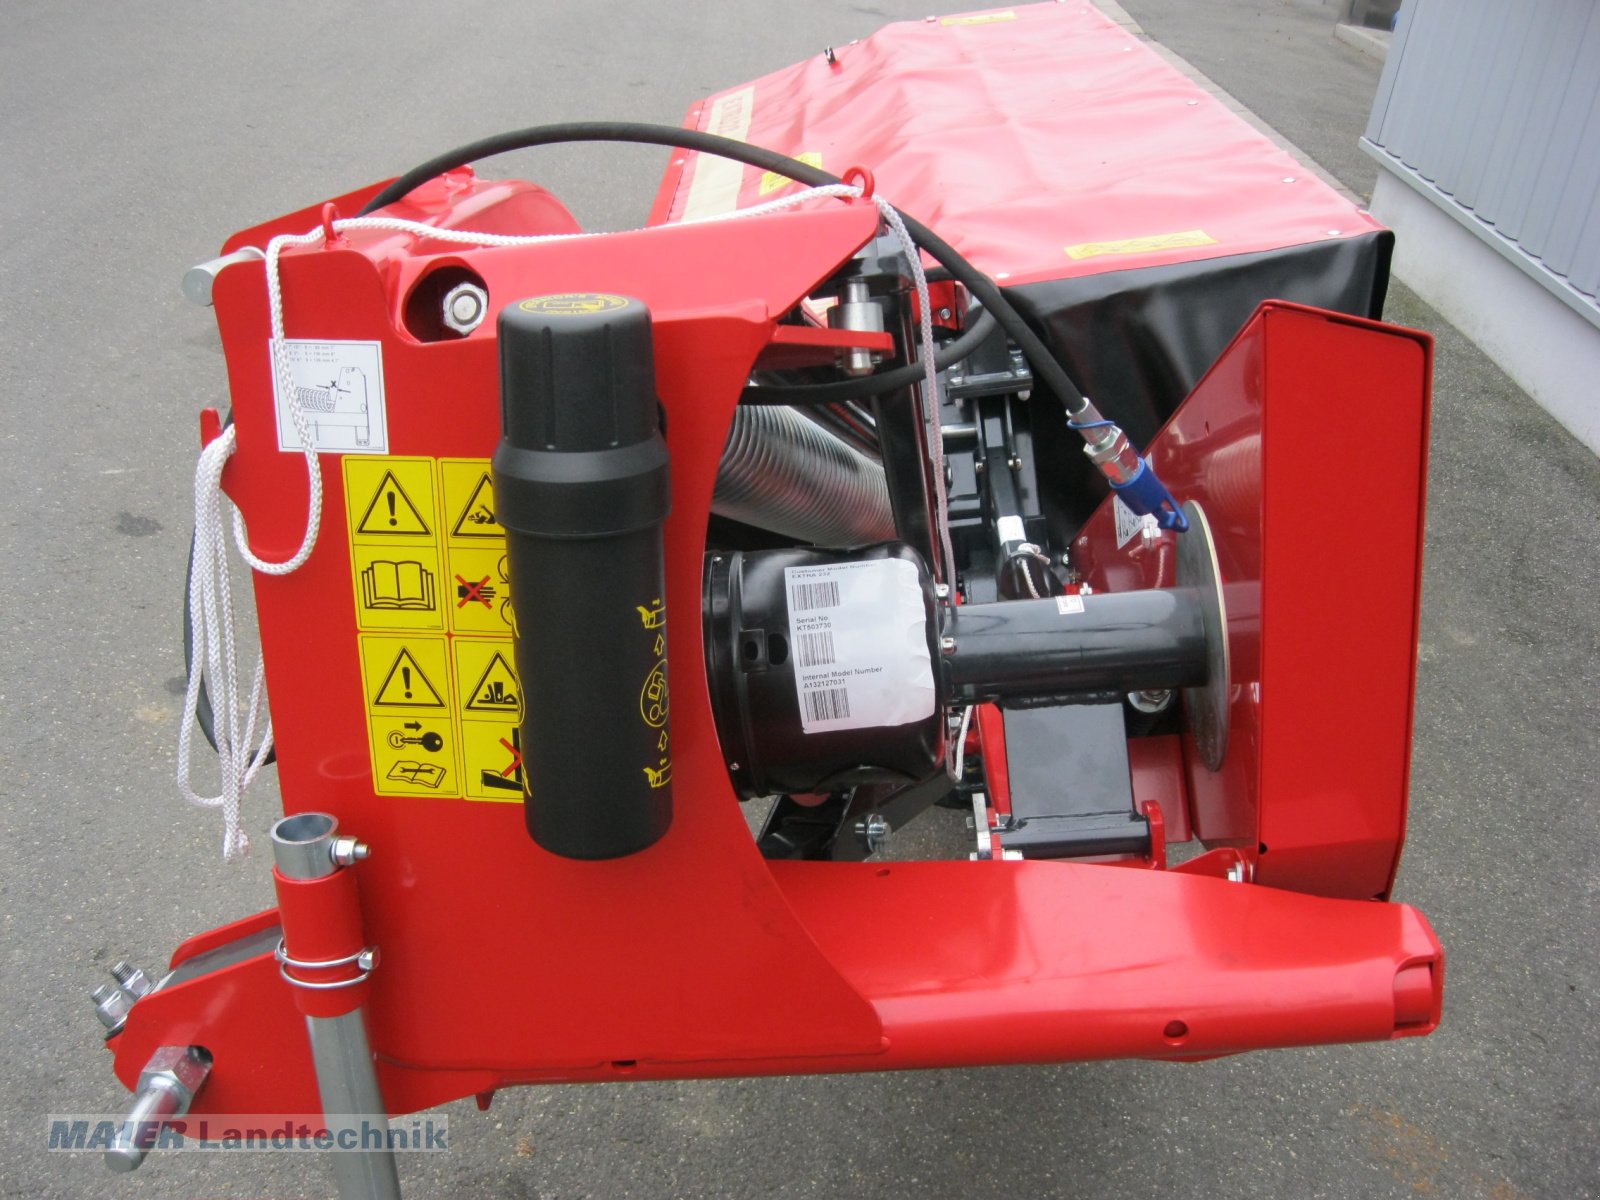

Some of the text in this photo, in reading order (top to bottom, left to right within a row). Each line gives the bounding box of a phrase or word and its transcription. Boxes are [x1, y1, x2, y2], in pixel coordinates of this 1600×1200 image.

[796, 615, 817, 624] Serial
[802, 666, 883, 681] Internal Model Number
[803, 678, 846, 689] A132127031
